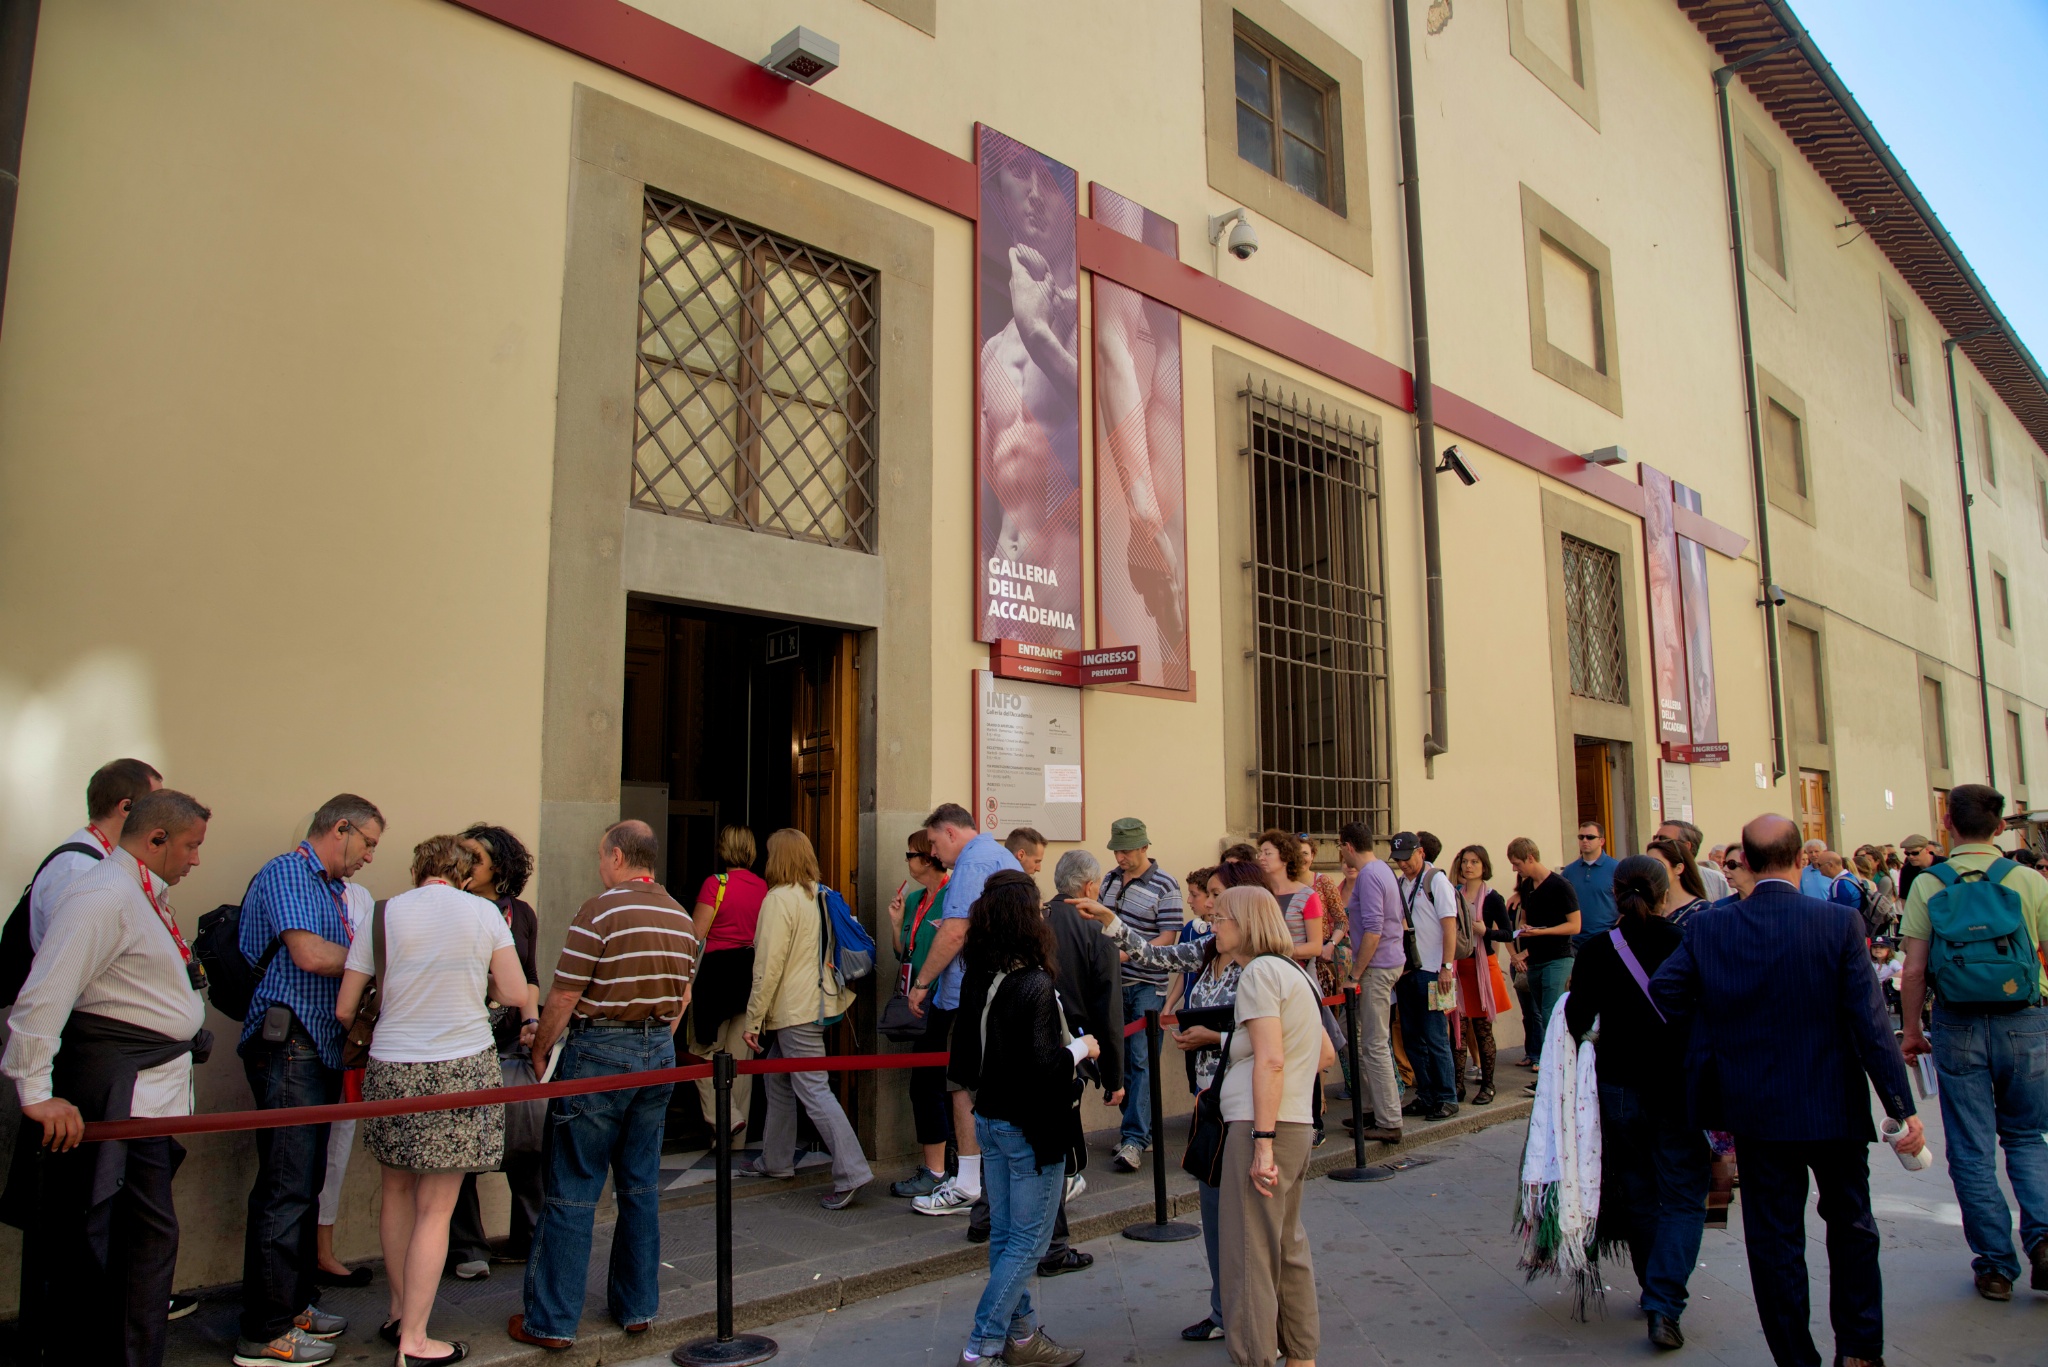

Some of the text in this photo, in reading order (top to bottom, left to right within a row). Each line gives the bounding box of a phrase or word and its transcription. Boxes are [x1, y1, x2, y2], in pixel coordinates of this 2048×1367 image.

[989, 557, 1058, 586] GALLERIA
[988, 578, 1035, 603] DELLA
[988, 599, 1076, 631] ACCADEMIA
[1018, 644, 1063, 660] ENTRANCE
[1083, 651, 1136, 665] INGRESSO
[1091, 667, 1128, 678] PRENOTATI
[986, 691, 1022, 710] INFO
[1661, 699, 1681, 711] GALLERIA
[1662, 710, 1675, 720] DELLA
[1663, 721, 1687, 733] ACCADEMIA
[1692, 745, 1728, 753] INGRESSO
